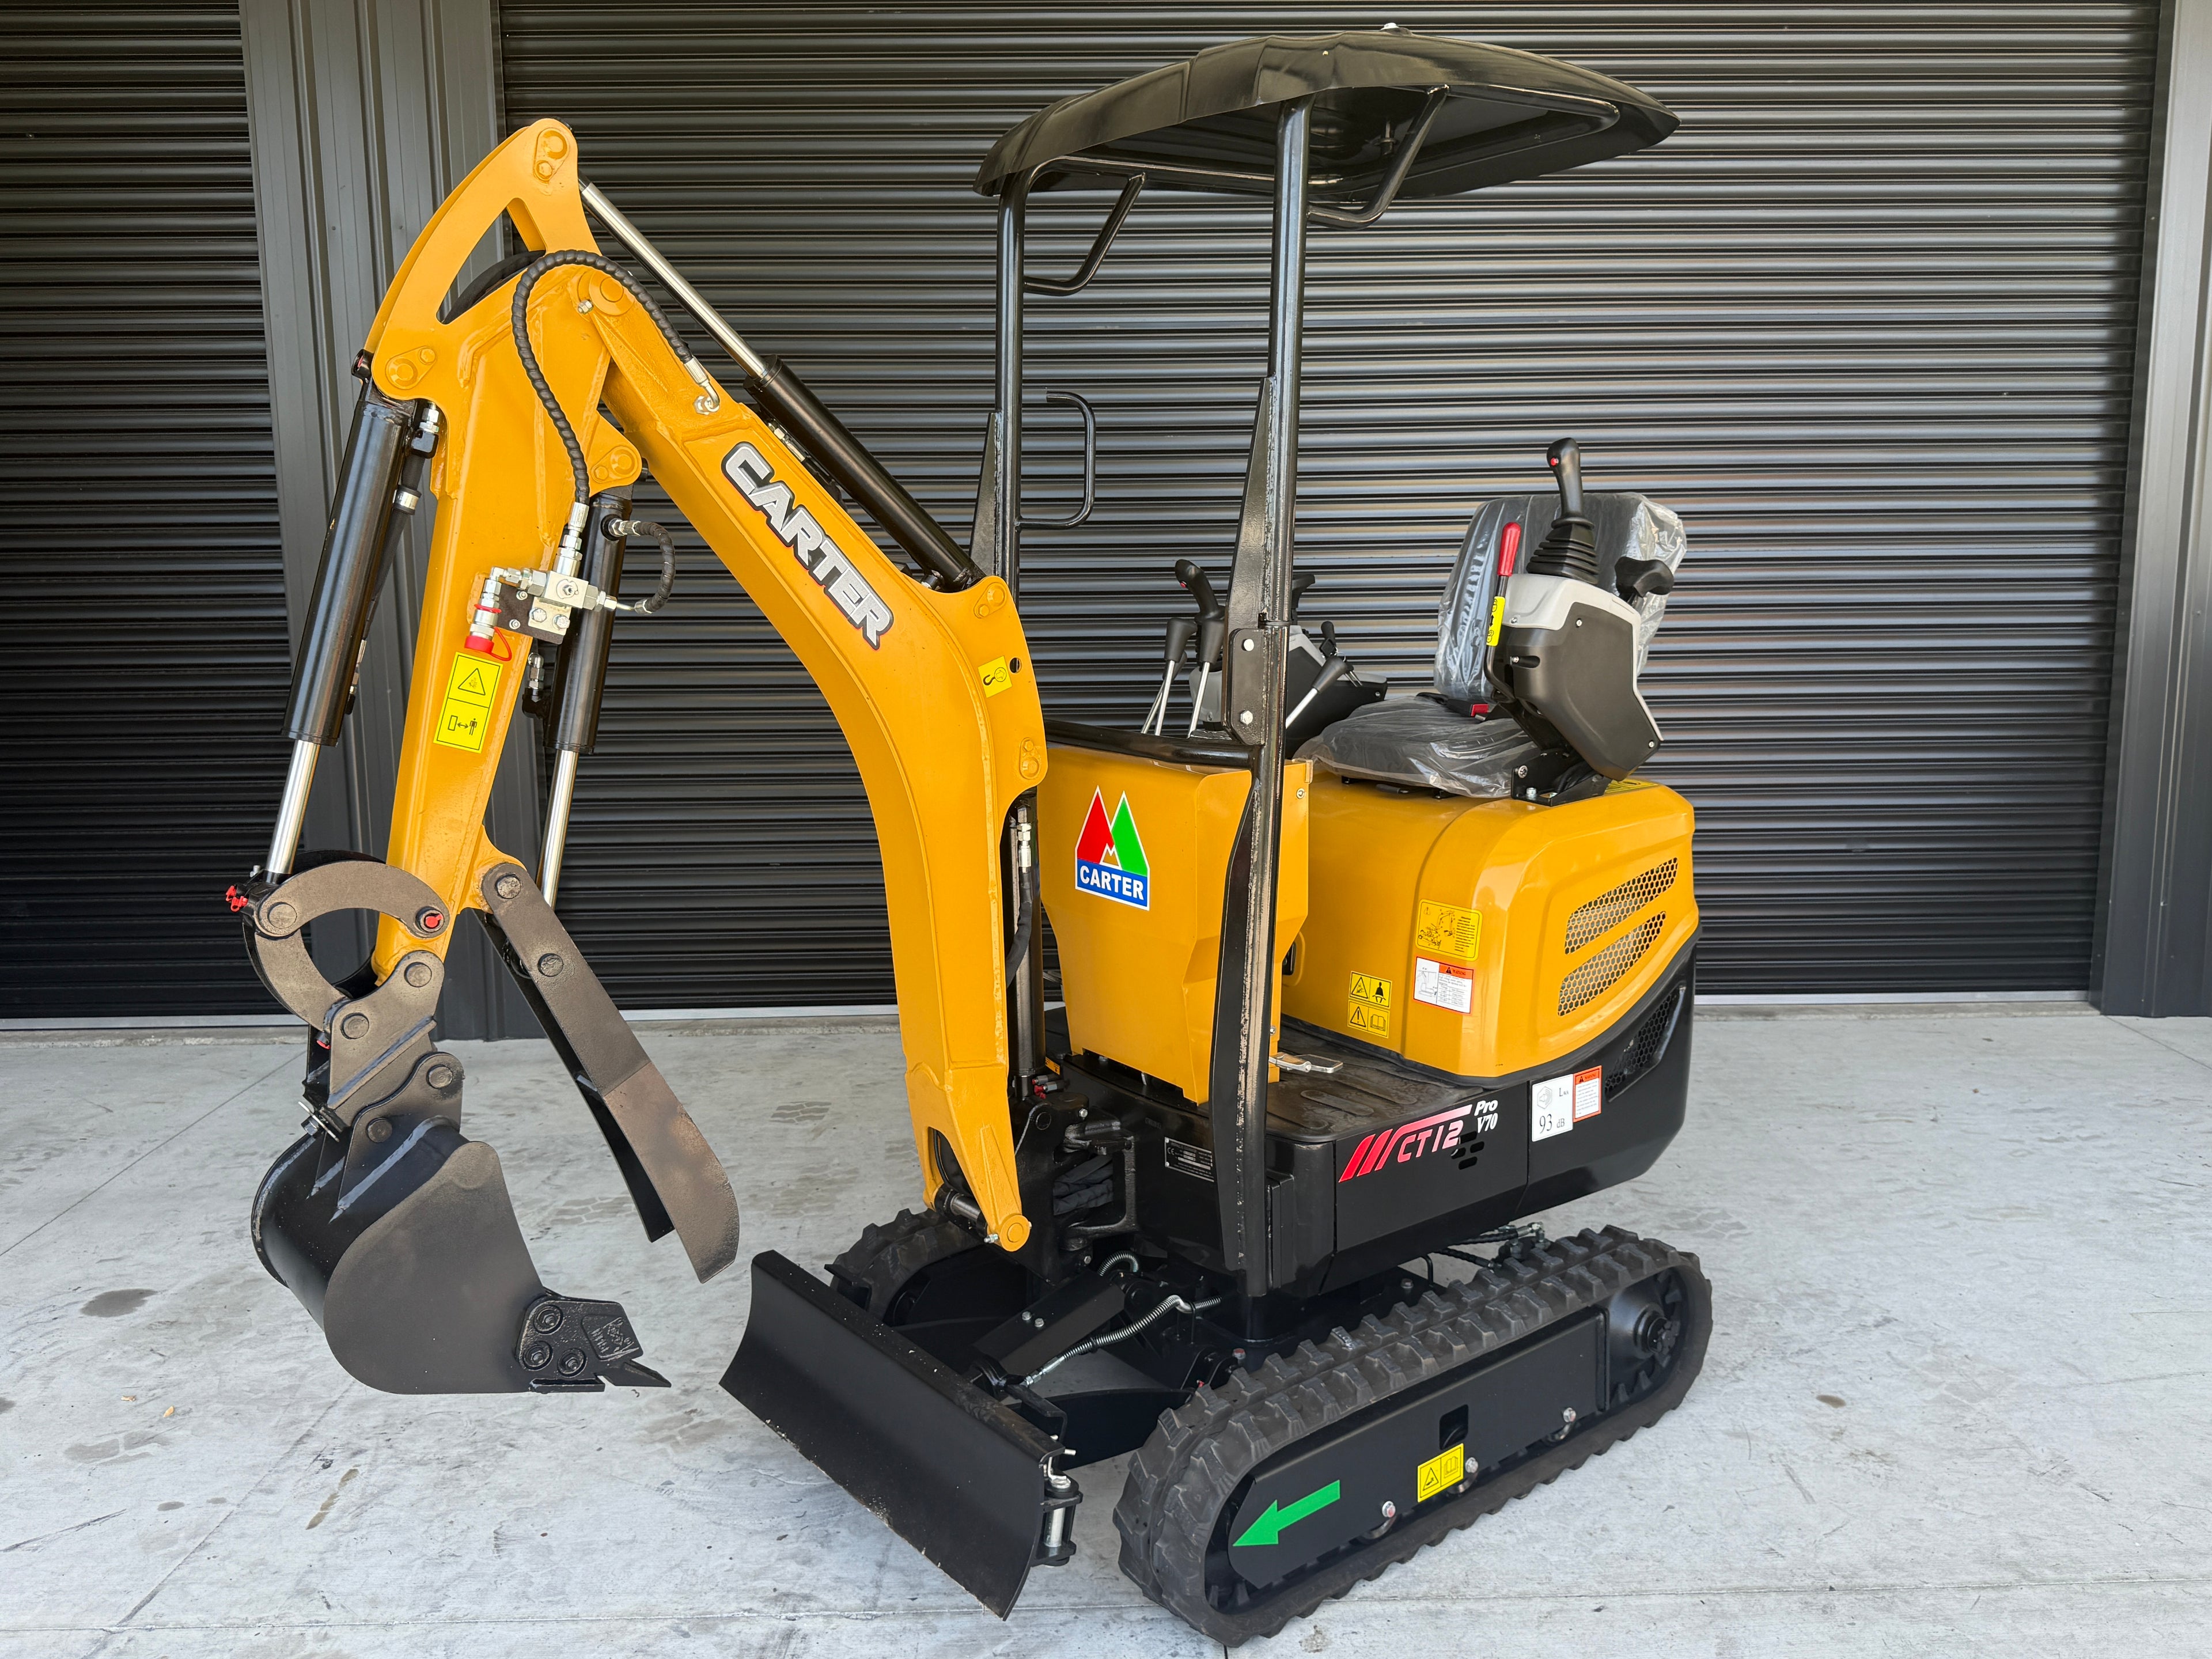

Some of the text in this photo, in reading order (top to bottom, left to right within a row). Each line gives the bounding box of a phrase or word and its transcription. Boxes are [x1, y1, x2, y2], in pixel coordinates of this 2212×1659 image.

[723, 444, 892, 648] CARTER
[1080, 865, 1144, 900] CARTER
[1474, 1100, 1498, 1116] Pro
[1477, 1112, 1498, 1134] V70
[1539, 1113, 1565, 1134] 93 dB
[1397, 1119, 1464, 1163] CT12
